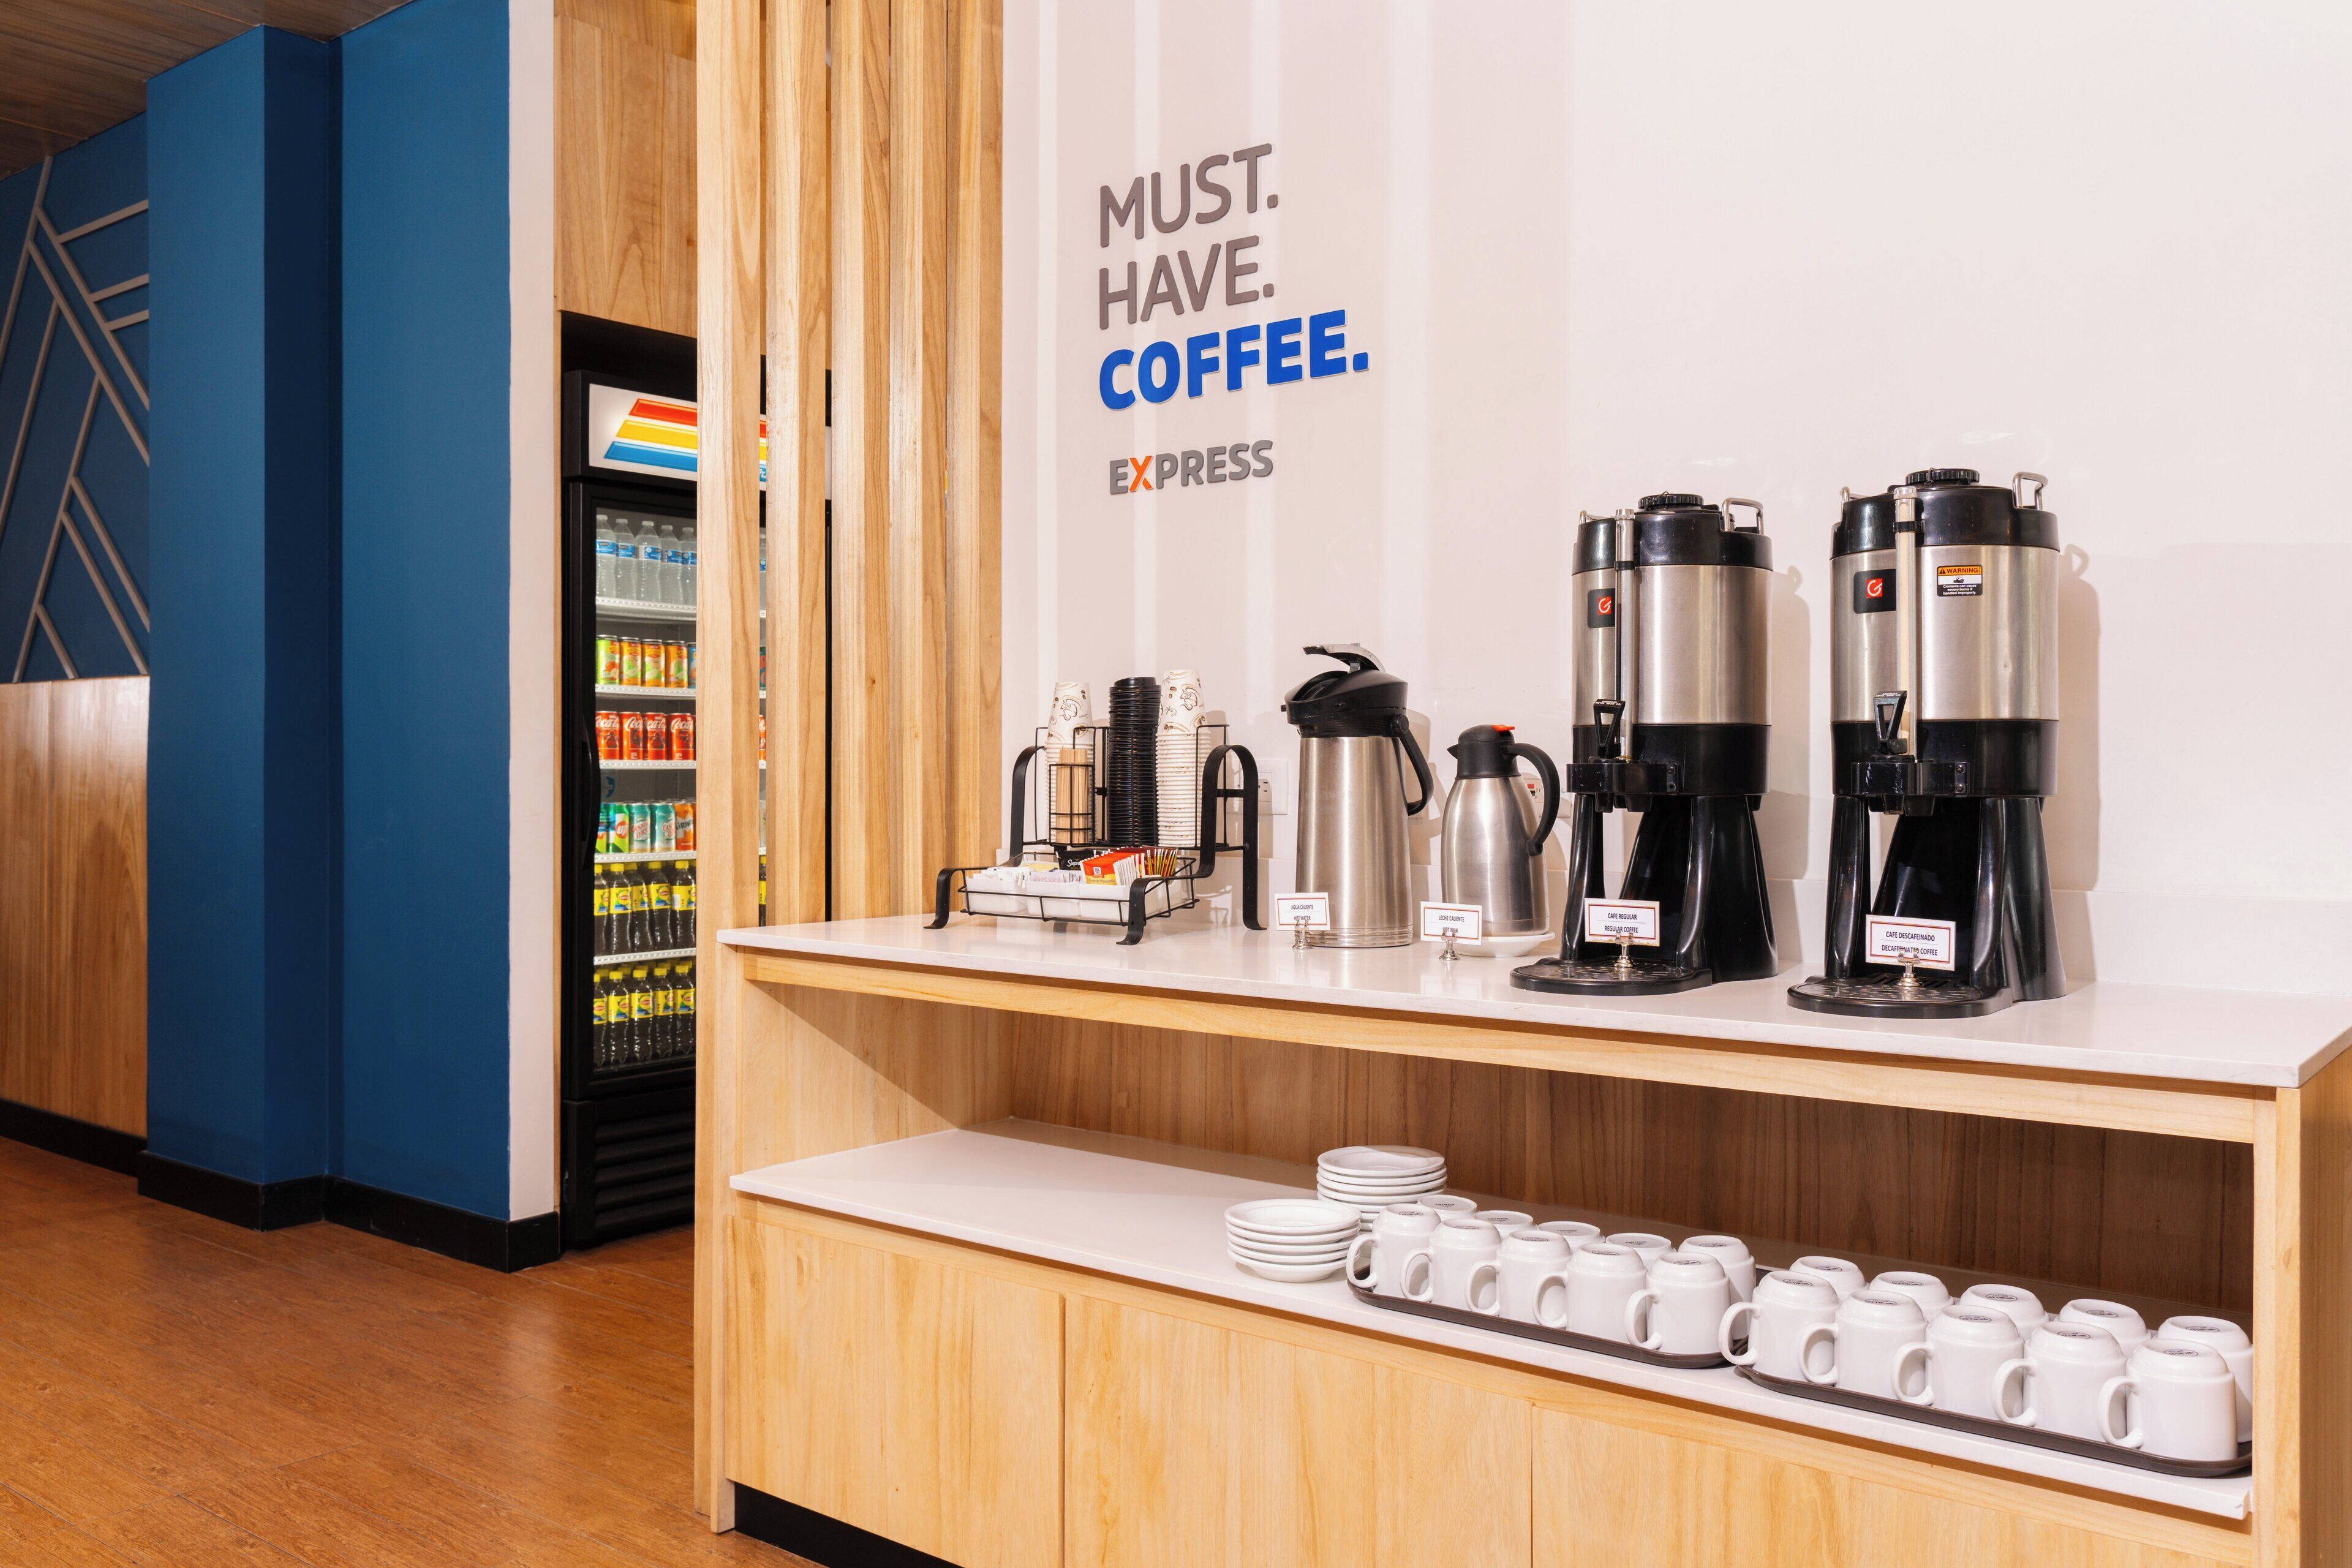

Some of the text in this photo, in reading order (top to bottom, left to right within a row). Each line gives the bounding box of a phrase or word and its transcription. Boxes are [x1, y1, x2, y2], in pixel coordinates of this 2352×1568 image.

[1100, 143, 1278, 247] MUST.
[1099, 235, 1275, 330] HAVE.
[1099, 309, 1370, 411] COFFEE.
[1109, 439, 1273, 495] EXPRESS
[1899, 932, 1935, 941] DESCAFEINADO
